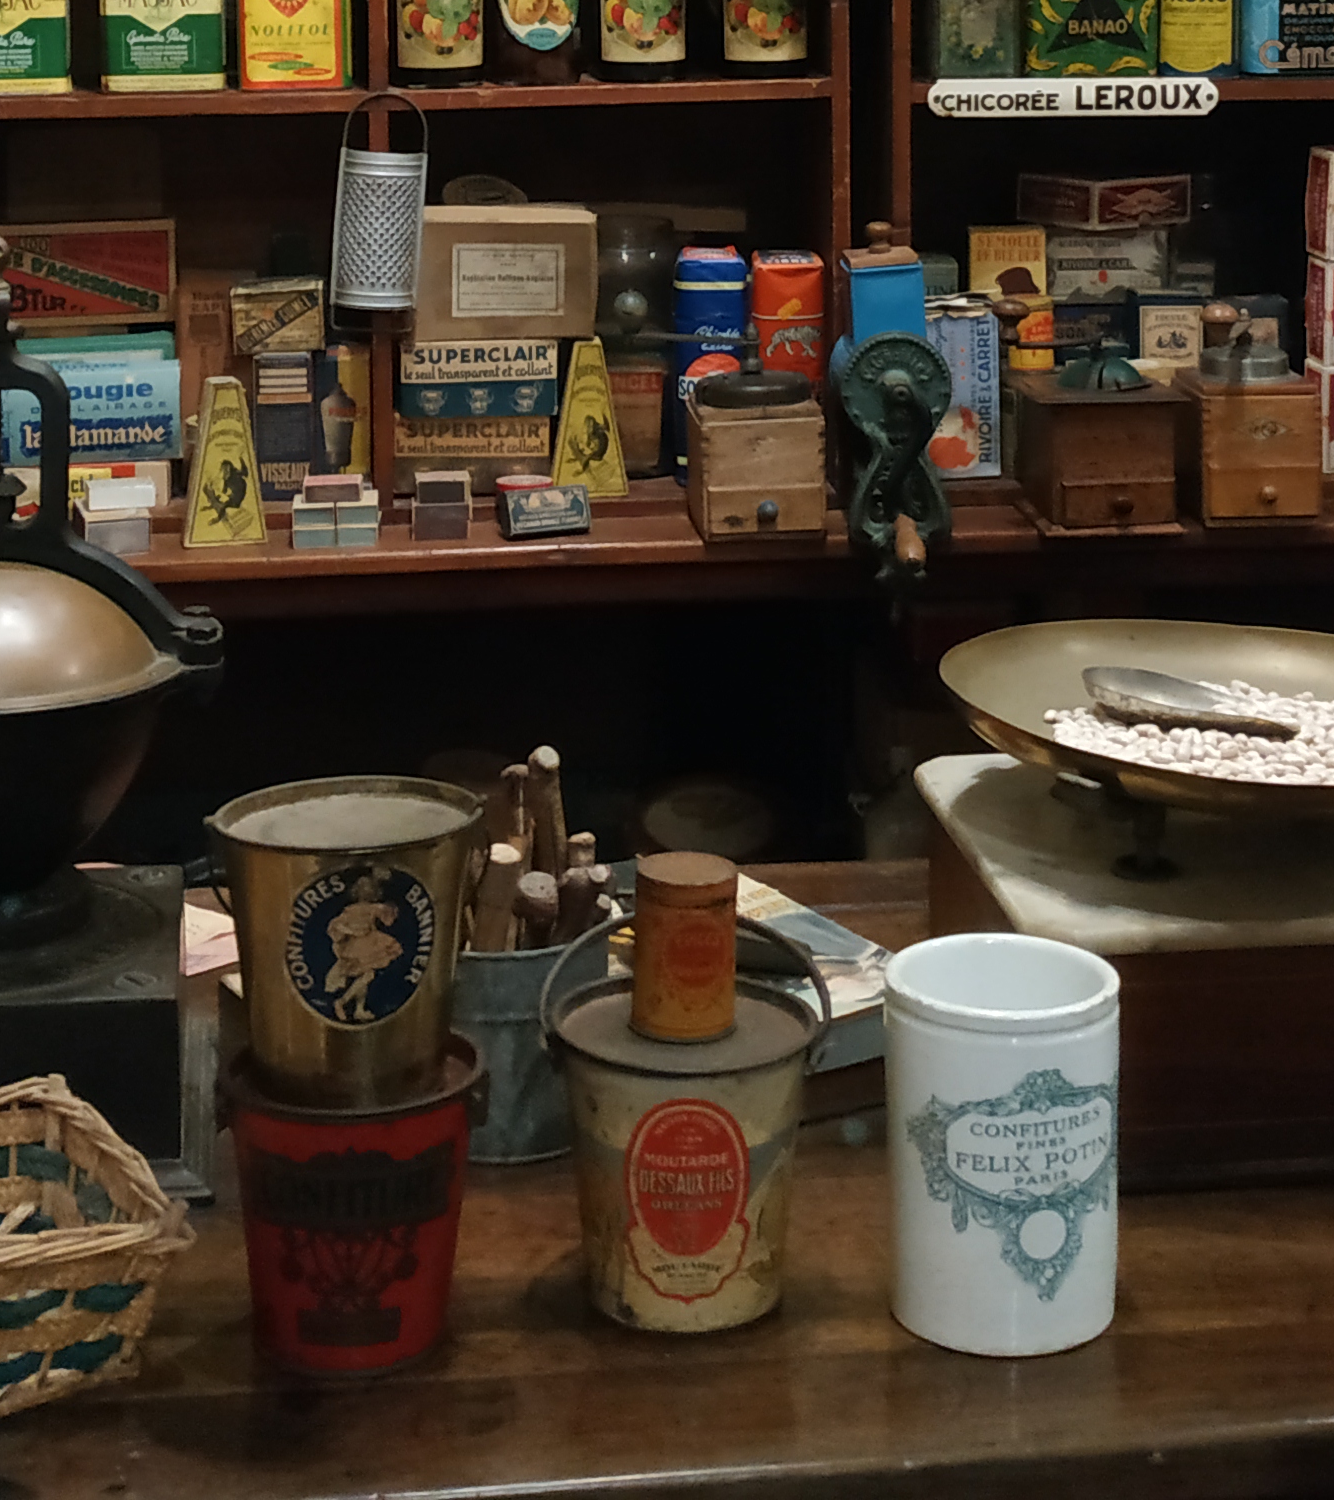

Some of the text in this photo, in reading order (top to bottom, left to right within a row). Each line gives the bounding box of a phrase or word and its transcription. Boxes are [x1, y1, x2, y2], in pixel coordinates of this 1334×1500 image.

[1068, 18, 1128, 35] BANAO
[941, 84, 1203, 113] CHICORÉE LEROUX
[436, 366, 500, 381] transparent
[502, 365, 513, 377] et
[515, 362, 553, 376] collant
[979, 318, 993, 464] RIVOIRE CARRET
[287, 874, 434, 990] CONFITURES BANNIER
[969, 1105, 1100, 1137] CONFITURES
[955, 1132, 1109, 1172] FELIX POTIN
[1016, 1136, 1066, 1150] FINES
[644, 1153, 729, 1167] MOUTARDE
[639, 1169, 705, 1195] DESSAUX
[1014, 1169, 1068, 1186] PARIS
